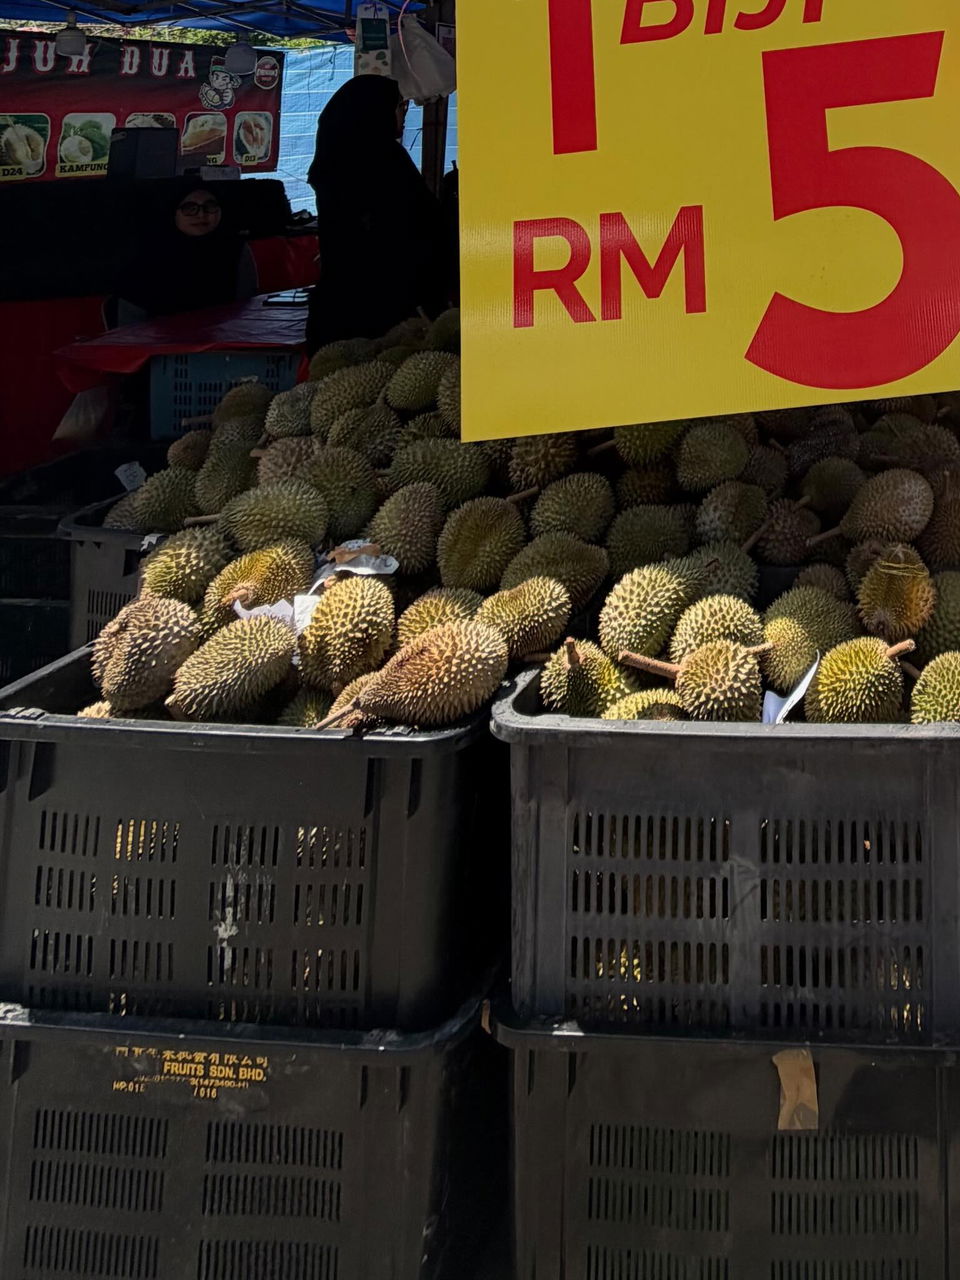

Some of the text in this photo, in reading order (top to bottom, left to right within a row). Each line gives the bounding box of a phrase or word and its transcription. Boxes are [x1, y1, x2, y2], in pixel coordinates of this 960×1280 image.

[121, 45, 195, 76] DUA
[513, 205, 707, 328] RM
[163, 1061, 266, 1081] FRUITS SDN. BHD.
